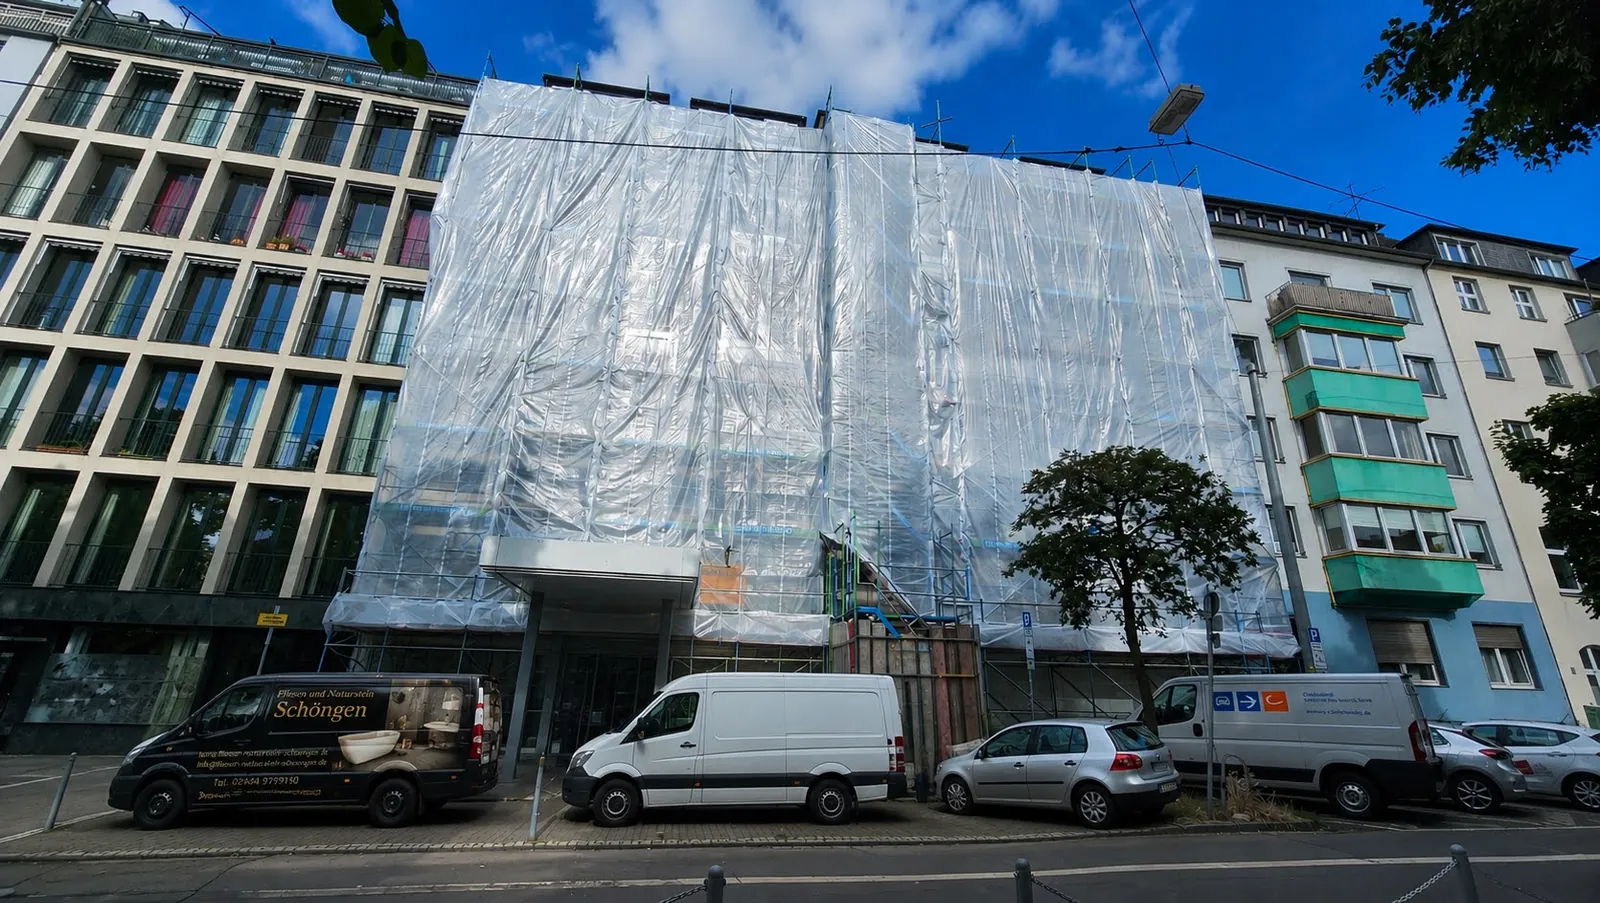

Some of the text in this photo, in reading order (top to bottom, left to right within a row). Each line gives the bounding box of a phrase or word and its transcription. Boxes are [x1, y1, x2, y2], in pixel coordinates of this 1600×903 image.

[1310, 629, 1318, 641] P
[309, 690, 325, 698] und
[327, 689, 375, 698] Naturstein
[273, 700, 368, 723] Schöngen
